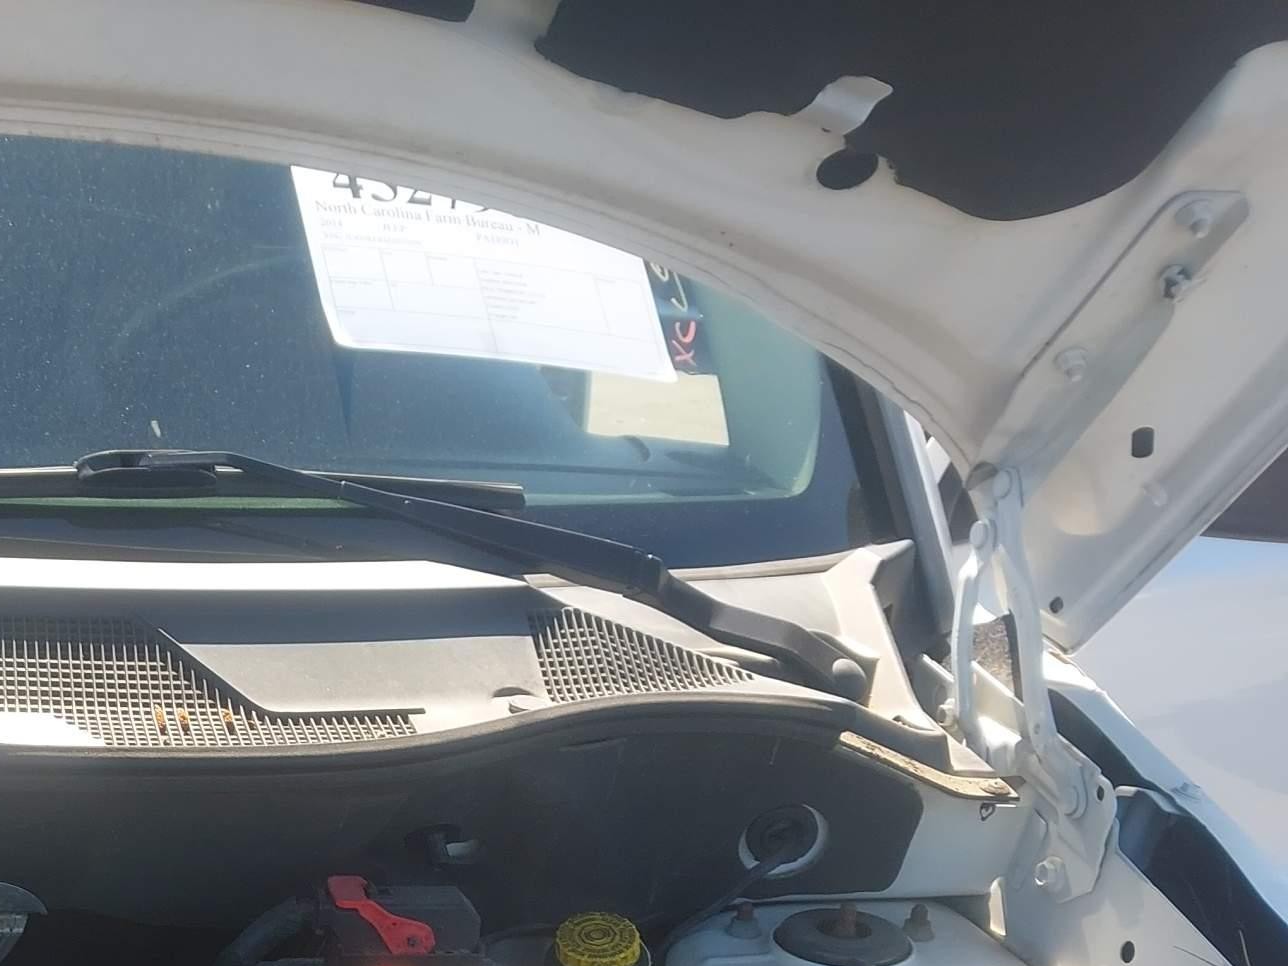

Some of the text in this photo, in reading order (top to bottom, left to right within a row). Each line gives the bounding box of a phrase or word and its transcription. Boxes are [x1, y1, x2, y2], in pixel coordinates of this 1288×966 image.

[315, 200, 357, 215] North
[361, 204, 422, 222] Carolina
[426, 211, 462, 226] Farm
[465, 213, 513, 232] Bureau
